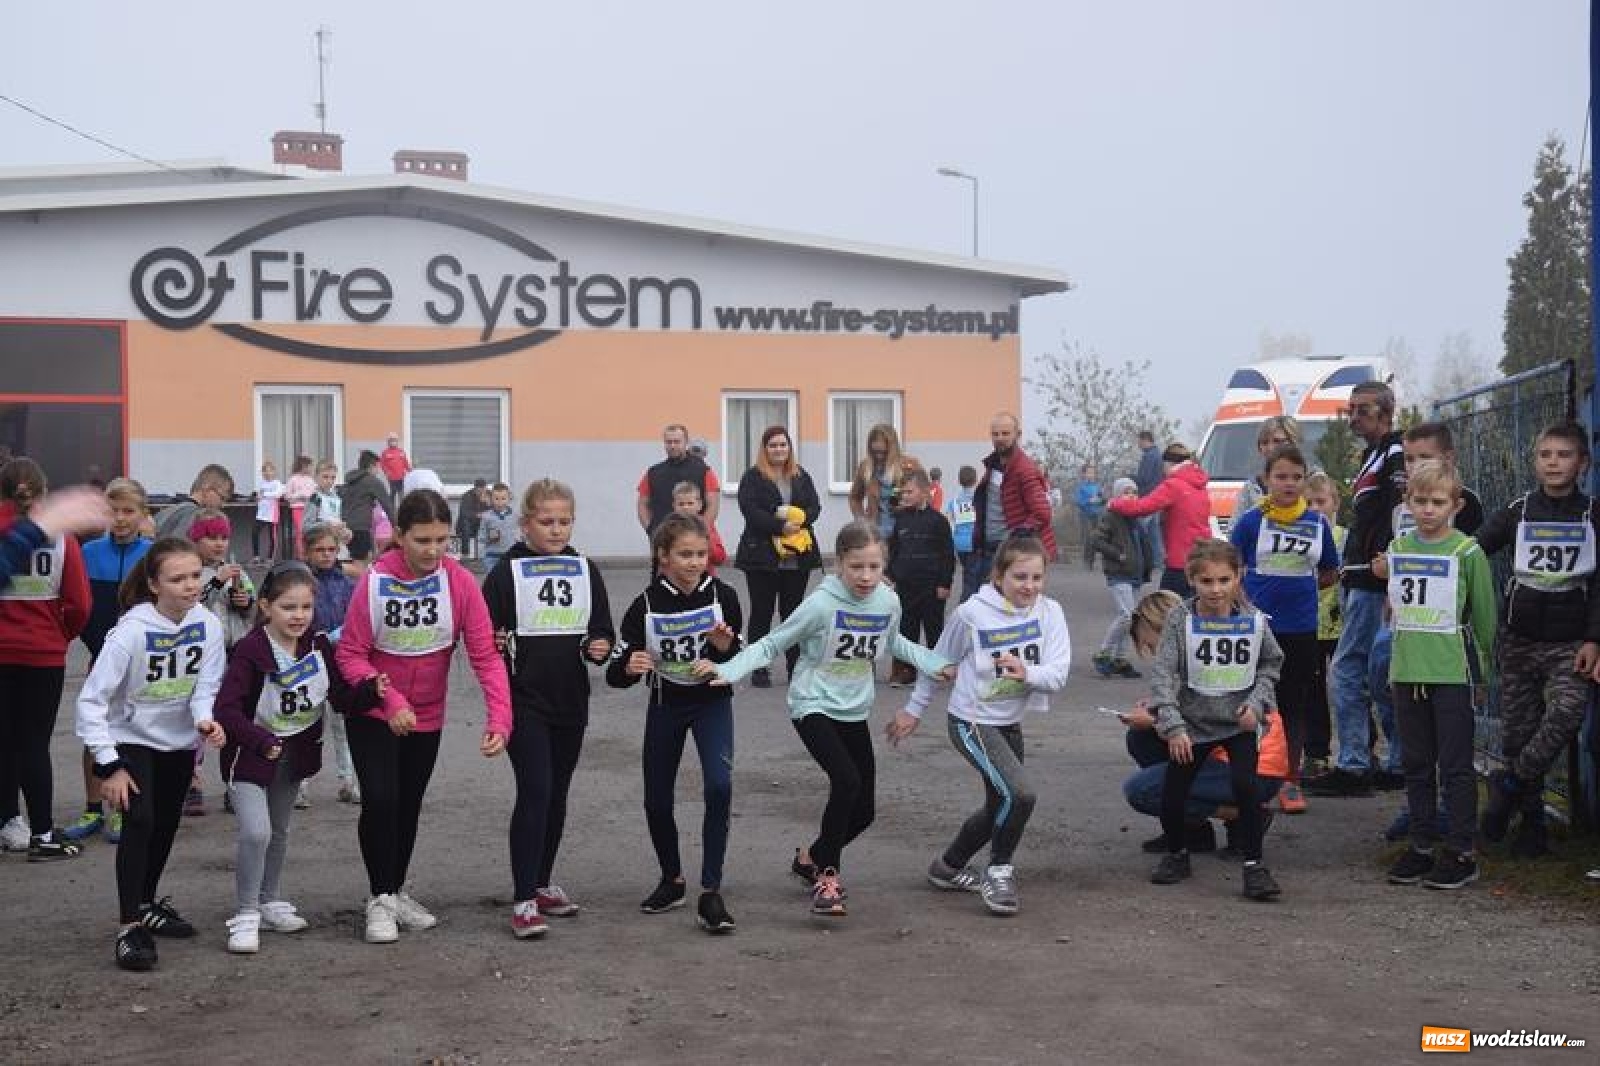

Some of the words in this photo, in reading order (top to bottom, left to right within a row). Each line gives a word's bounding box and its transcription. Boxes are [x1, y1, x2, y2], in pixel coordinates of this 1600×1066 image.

[250, 249, 393, 323] Fire
[425, 253, 703, 342] System
[714, 299, 1020, 341] www.fire-system.pl
[1527, 544, 1581, 573] 297
[537, 577, 574, 607] 43
[1400, 577, 1428, 606] 31
[384, 596, 439, 629] 833
[836, 632, 881, 660] 245
[1195, 637, 1251, 667] 496
[146, 645, 203, 682] 512
[279, 685, 314, 715] 83
